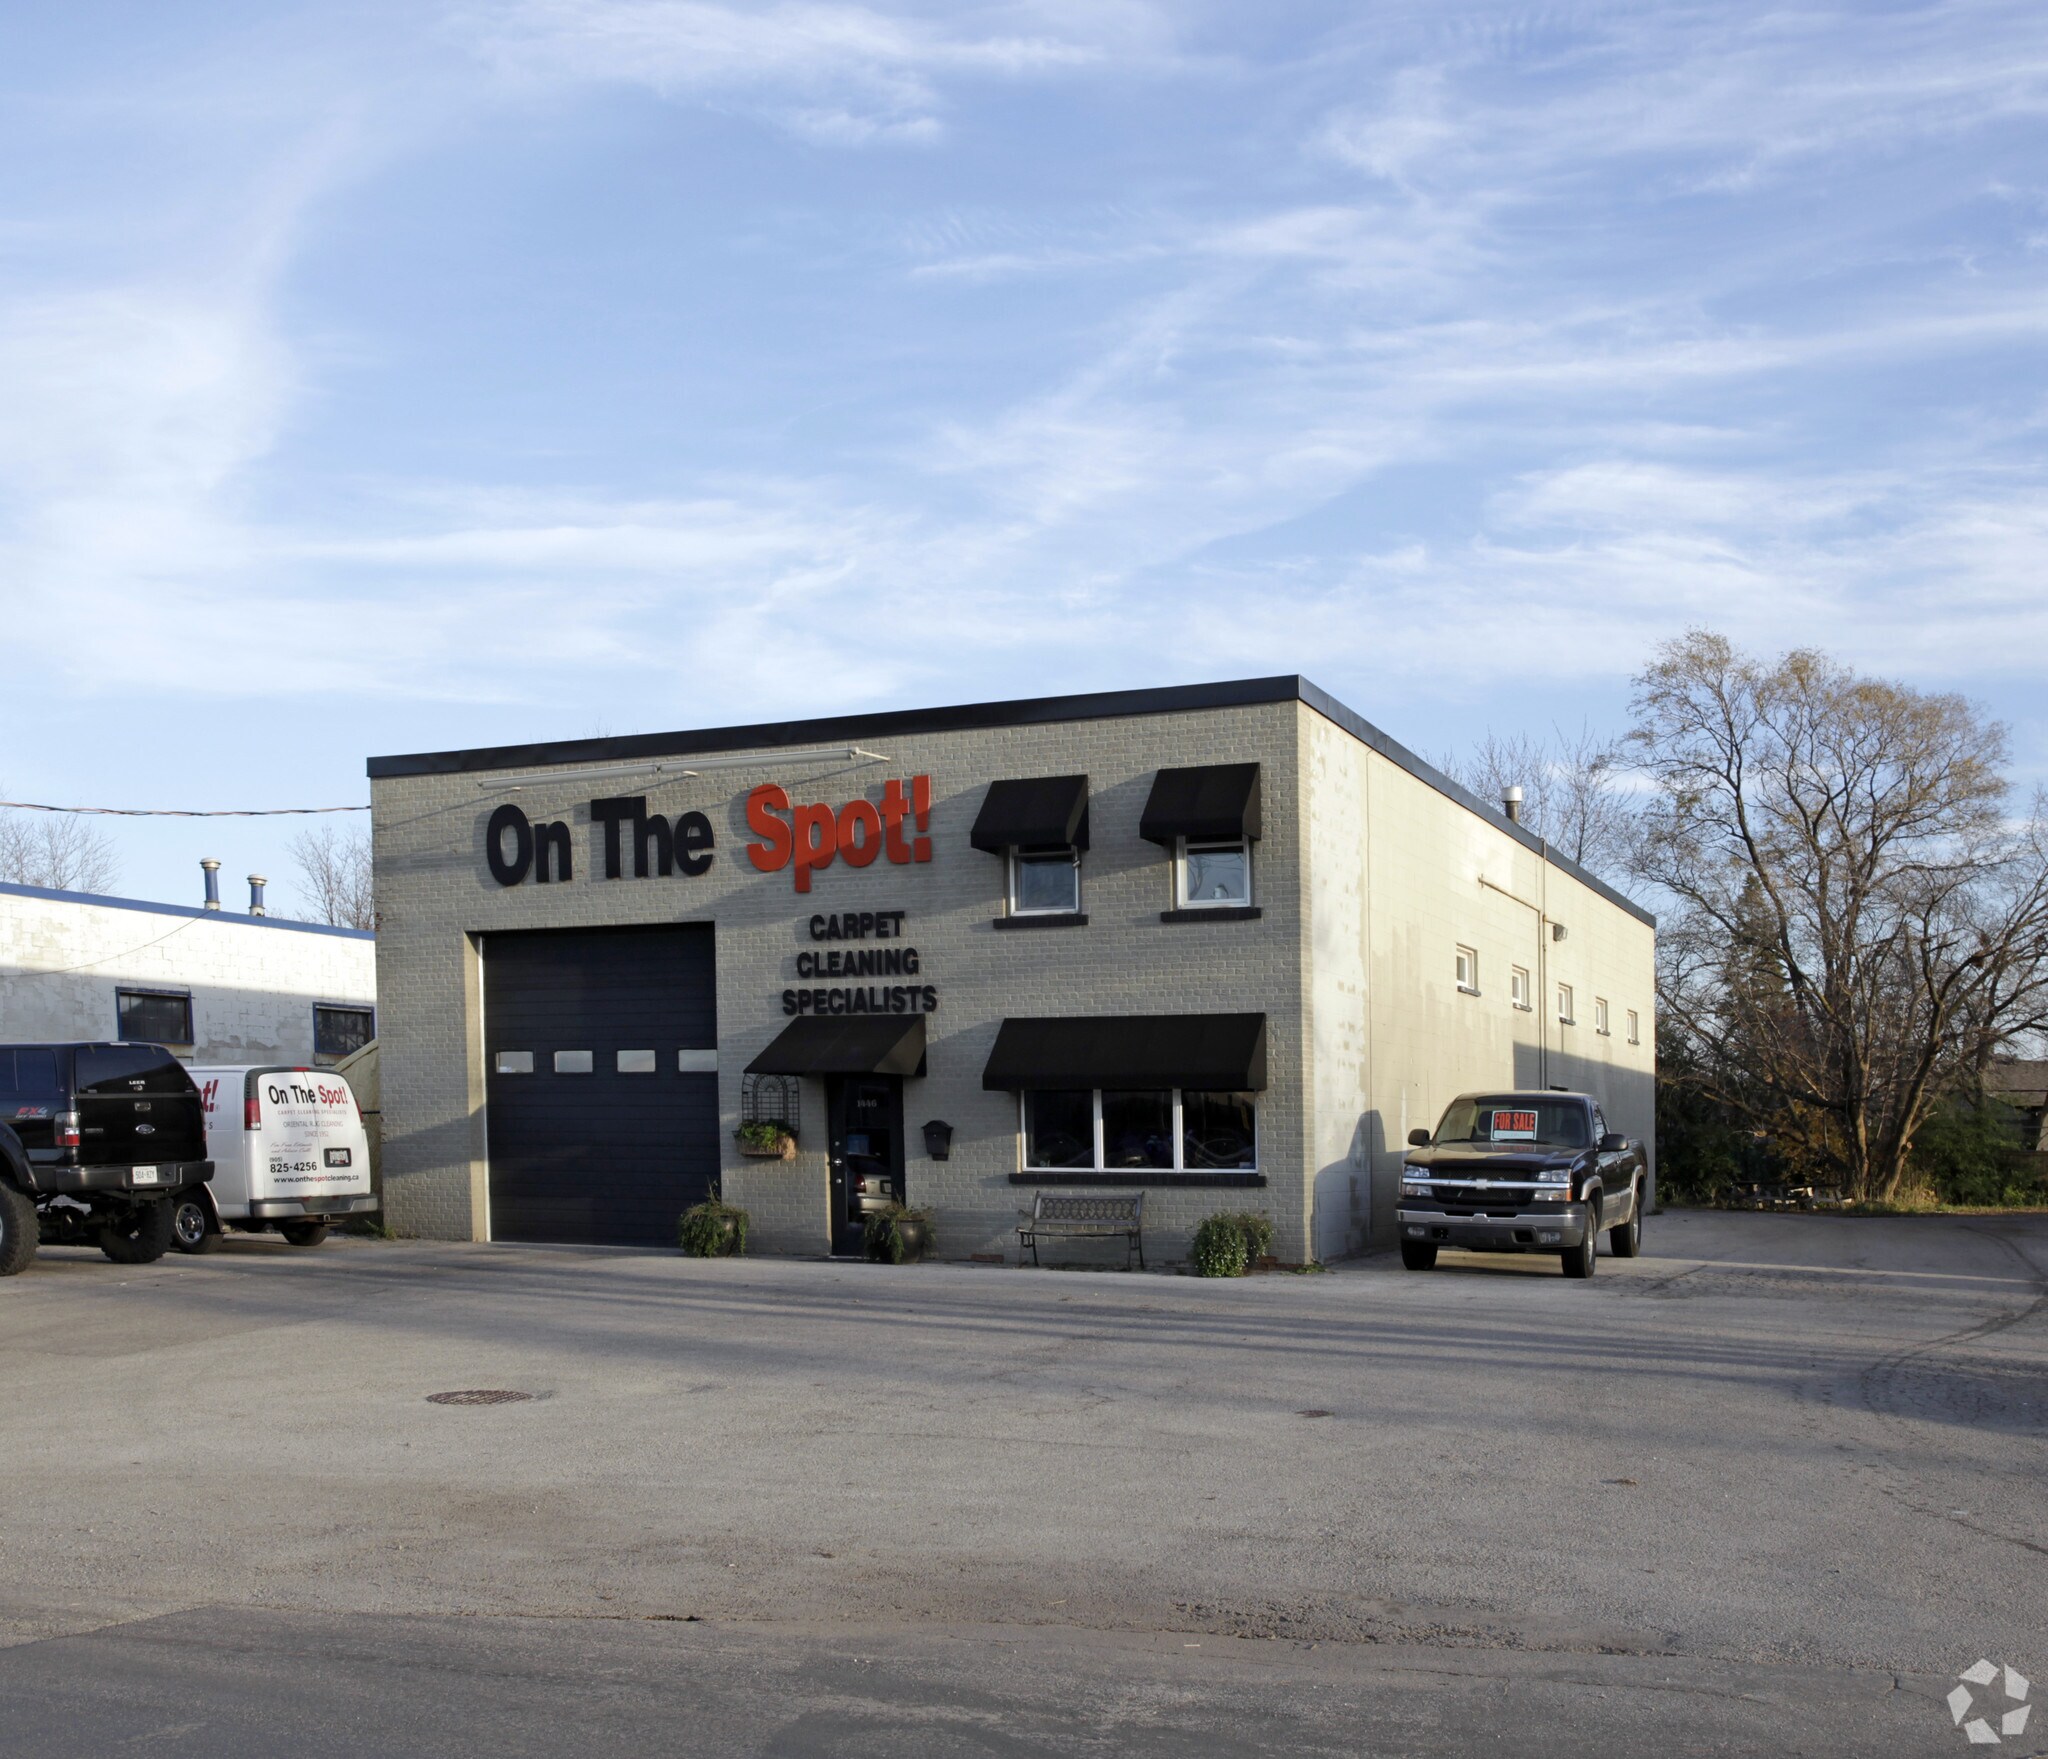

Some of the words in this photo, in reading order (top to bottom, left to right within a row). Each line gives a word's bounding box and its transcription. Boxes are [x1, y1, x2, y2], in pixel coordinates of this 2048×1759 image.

[487, 803, 572, 887] On
[591, 796, 715, 879] The
[746, 775, 932, 893] Spot!
[809, 911, 905, 941] CARPET
[797, 947, 919, 978] CLEANING
[782, 985, 938, 1016] SPECIALISTS
[268, 1085, 289, 1105] On
[290, 1085, 316, 1104] The
[318, 1084, 348, 1108] Spot!
[1494, 1112, 1511, 1130] FOR
[1513, 1112, 1535, 1130] SALE
[270, 1162, 317, 1173] 825-4256
[273, 1174, 360, 1183] www.onthespotcleaning.ca
